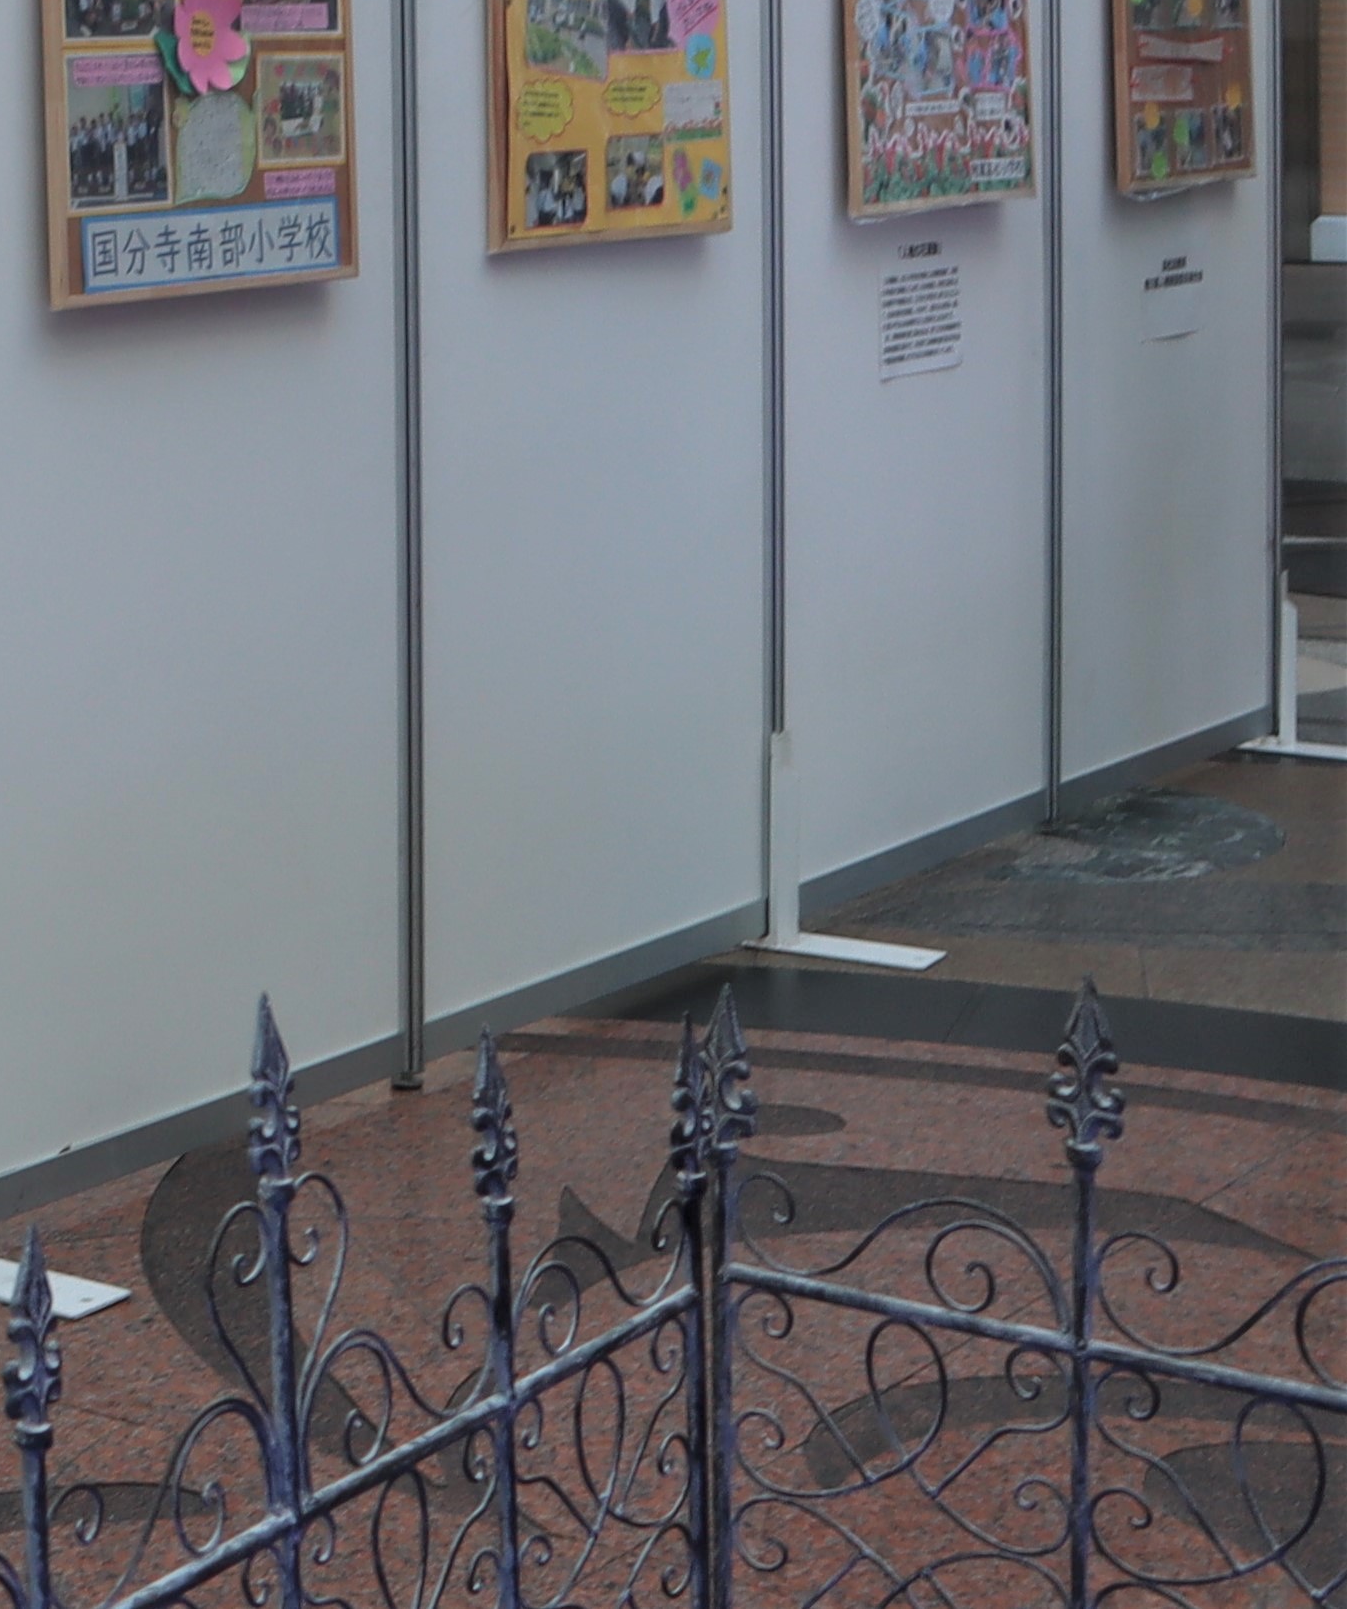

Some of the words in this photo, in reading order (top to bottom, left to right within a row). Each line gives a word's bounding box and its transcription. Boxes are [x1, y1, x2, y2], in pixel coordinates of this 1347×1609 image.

[91, 211, 333, 278] 国分寺南部小学校
